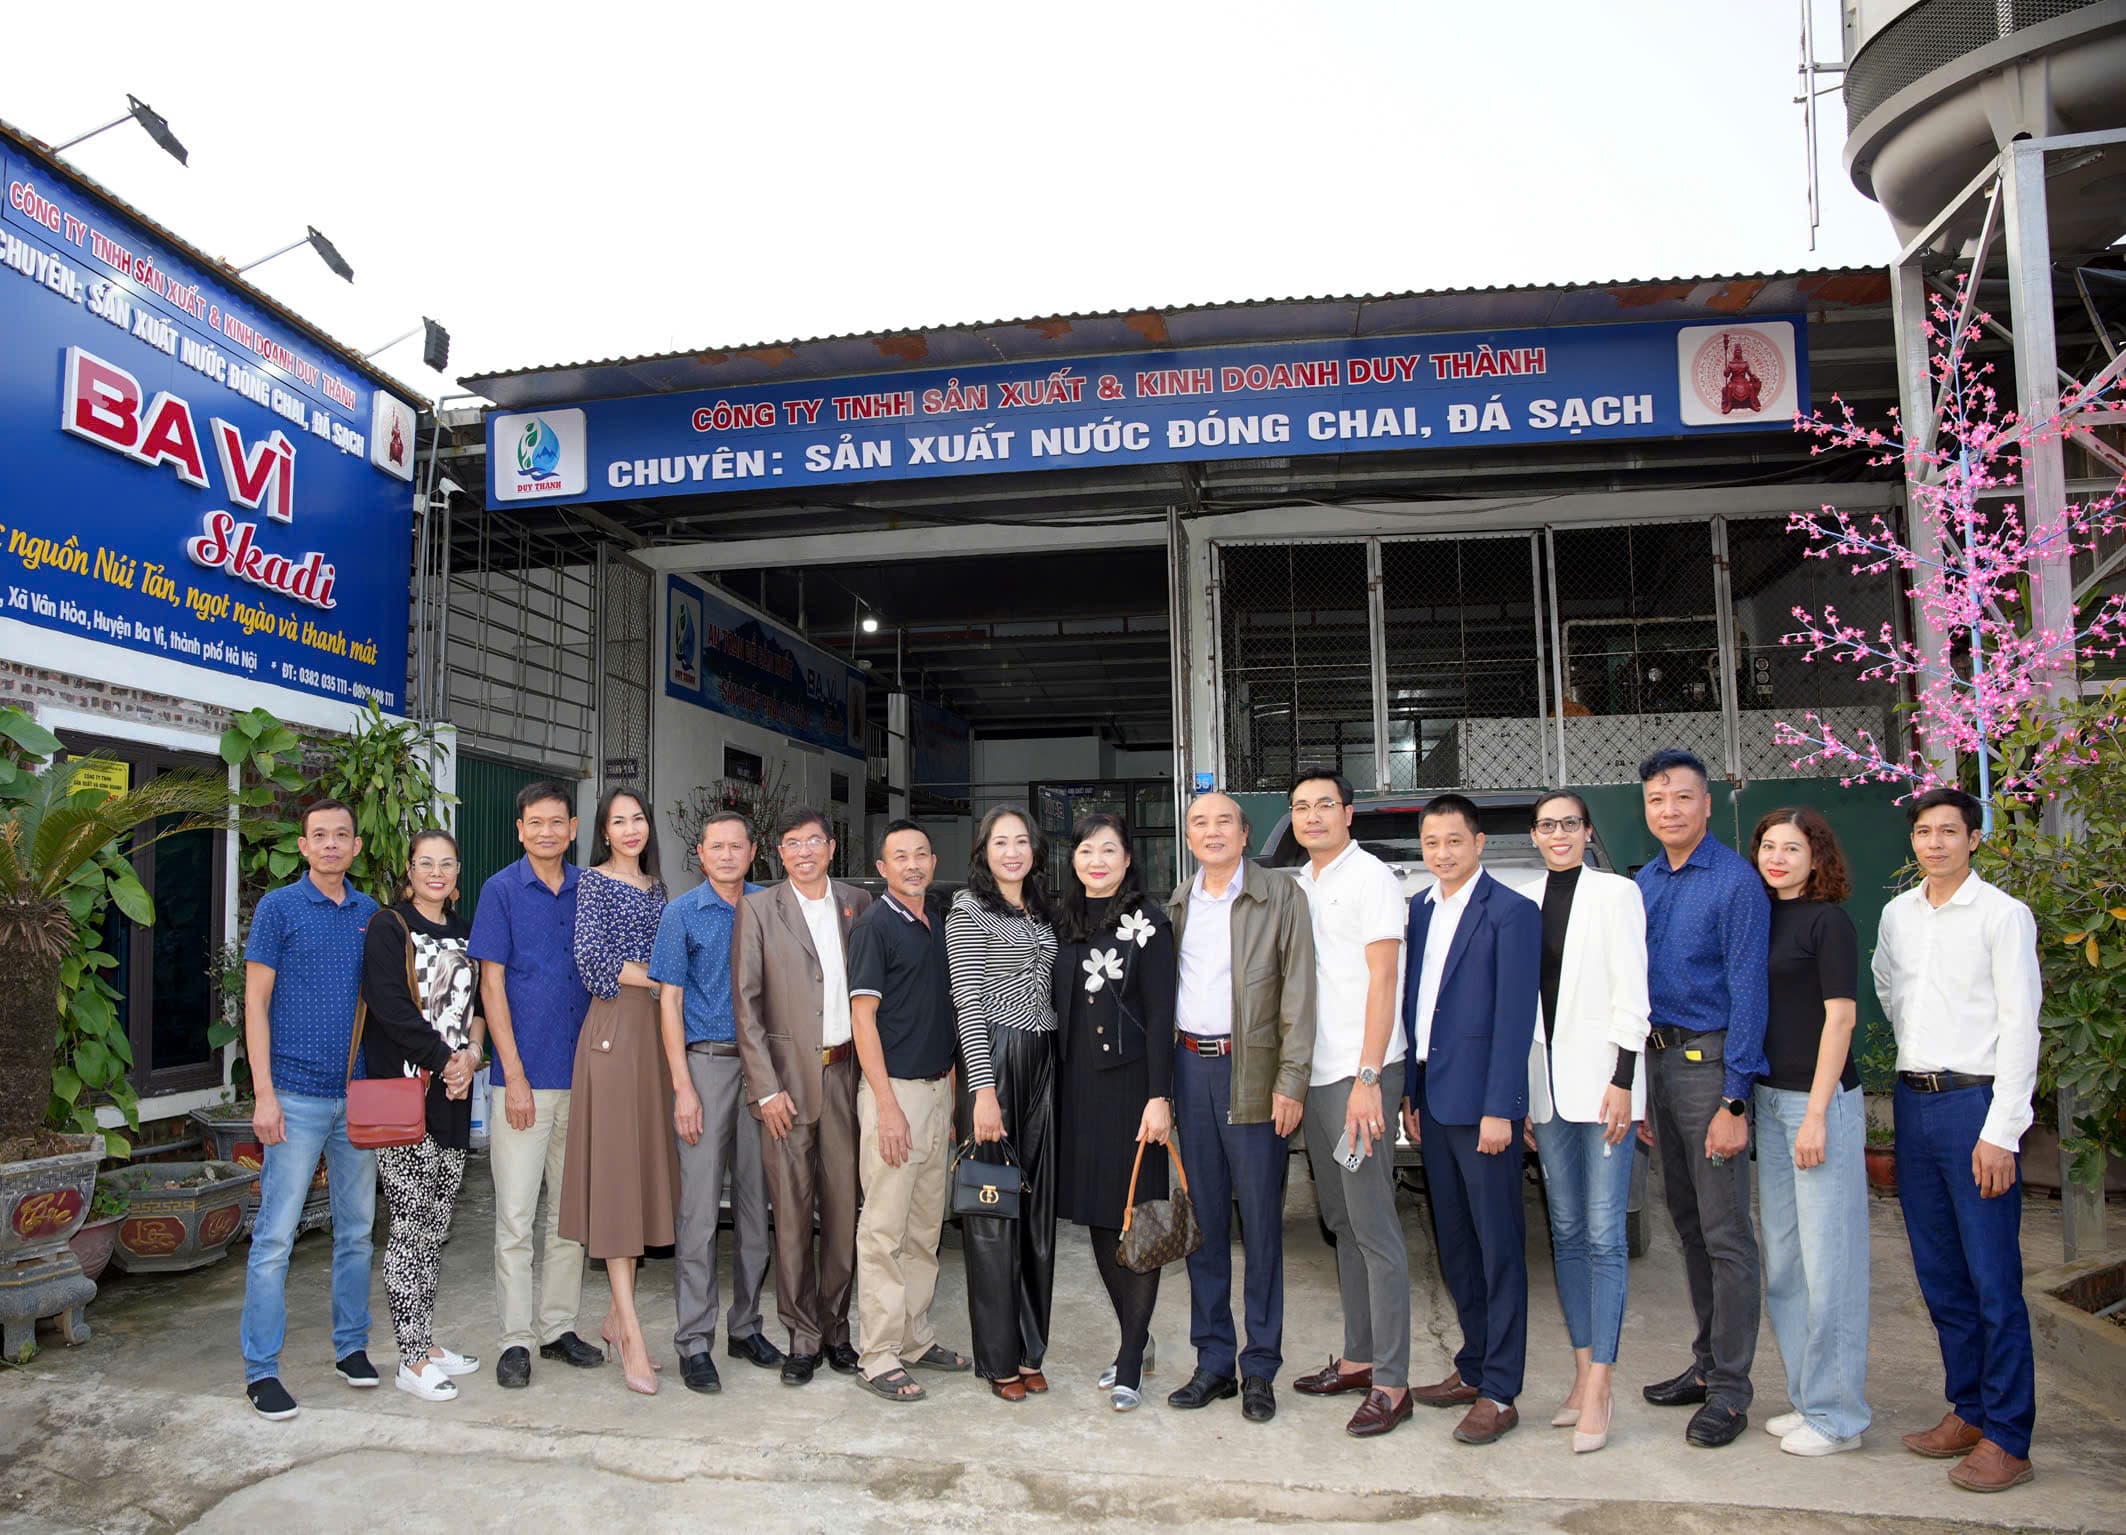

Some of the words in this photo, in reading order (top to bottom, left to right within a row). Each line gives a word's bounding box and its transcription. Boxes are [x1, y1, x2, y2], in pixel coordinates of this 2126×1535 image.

[10, 181, 61, 233] CÔNG
[63, 212, 88, 247] TY
[90, 228, 133, 277] TNHH
[134, 256, 165, 297] SẢN
[166, 285, 206, 321] XUẤT
[209, 305, 221, 332] &
[224, 312, 254, 350] KINH
[254, 332, 295, 375] DOANH
[295, 354, 319, 388] DUY
[321, 374, 356, 412] THÀNH
[62, 345, 210, 488] BA
[210, 416, 297, 523] VÌ
[131, 317, 178, 356] XUẤT
[179, 335, 227, 383] NƯỚC
[226, 362, 270, 408] ĐÓNG
[271, 388, 309, 430] CHAI,
[311, 410, 331, 440] ĐÁ
[331, 422, 365, 459] SẠCH
[692, 400, 776, 432] CÔNG
[783, 398, 824, 425] TY
[831, 390, 915, 422] TNHH
[922, 377, 988, 415] SẢN
[997, 367, 1087, 408] XUẤT
[1097, 374, 1126, 403] &
[1136, 367, 1213, 398] KINH
[1221, 359, 1340, 393] DOANH
[1347, 354, 1421, 386] DUY
[1429, 344, 1547, 381] THÀNH
[517, 484, 533, 492] DUY
[607, 447, 784, 488] CHUYÊN:
[805, 433, 892, 472] SẢN
[908, 422, 1015, 465] XUẤT
[1031, 415, 1150, 457] NƯỚC
[1166, 409, 1290, 449] ĐÓNG
[1308, 406, 1432, 441] CHAI,
[1447, 394, 1511, 433] ĐÁ
[1528, 394, 1654, 434] SẠCH
[8, 528, 89, 576] nguồn
[94, 547, 137, 589] Núi
[141, 561, 181, 608] Tản,
[186, 586, 230, 623] ngọt
[232, 601, 276, 635] ngào
[278, 612, 298, 642] và
[302, 621, 346, 657] thanh
[349, 637, 378, 666] mát
[187, 510, 337, 609] Skadi
[8, 585, 28, 610] Xã
[31, 592, 57, 618] Vân
[60, 600, 91, 630] Hòa,
[93, 610, 131, 640] Huyện
[135, 621, 150, 642] Ba
[170, 628, 200, 656] thành
[203, 640, 224, 661] phố
[225, 644, 240, 667] Hà
[241, 653, 258, 674] Nội
[282, 662, 297, 681] ĐT:
[299, 667, 319, 687] 0382
[321, 673, 336, 691] 035
[337, 677, 347, 695] 111
